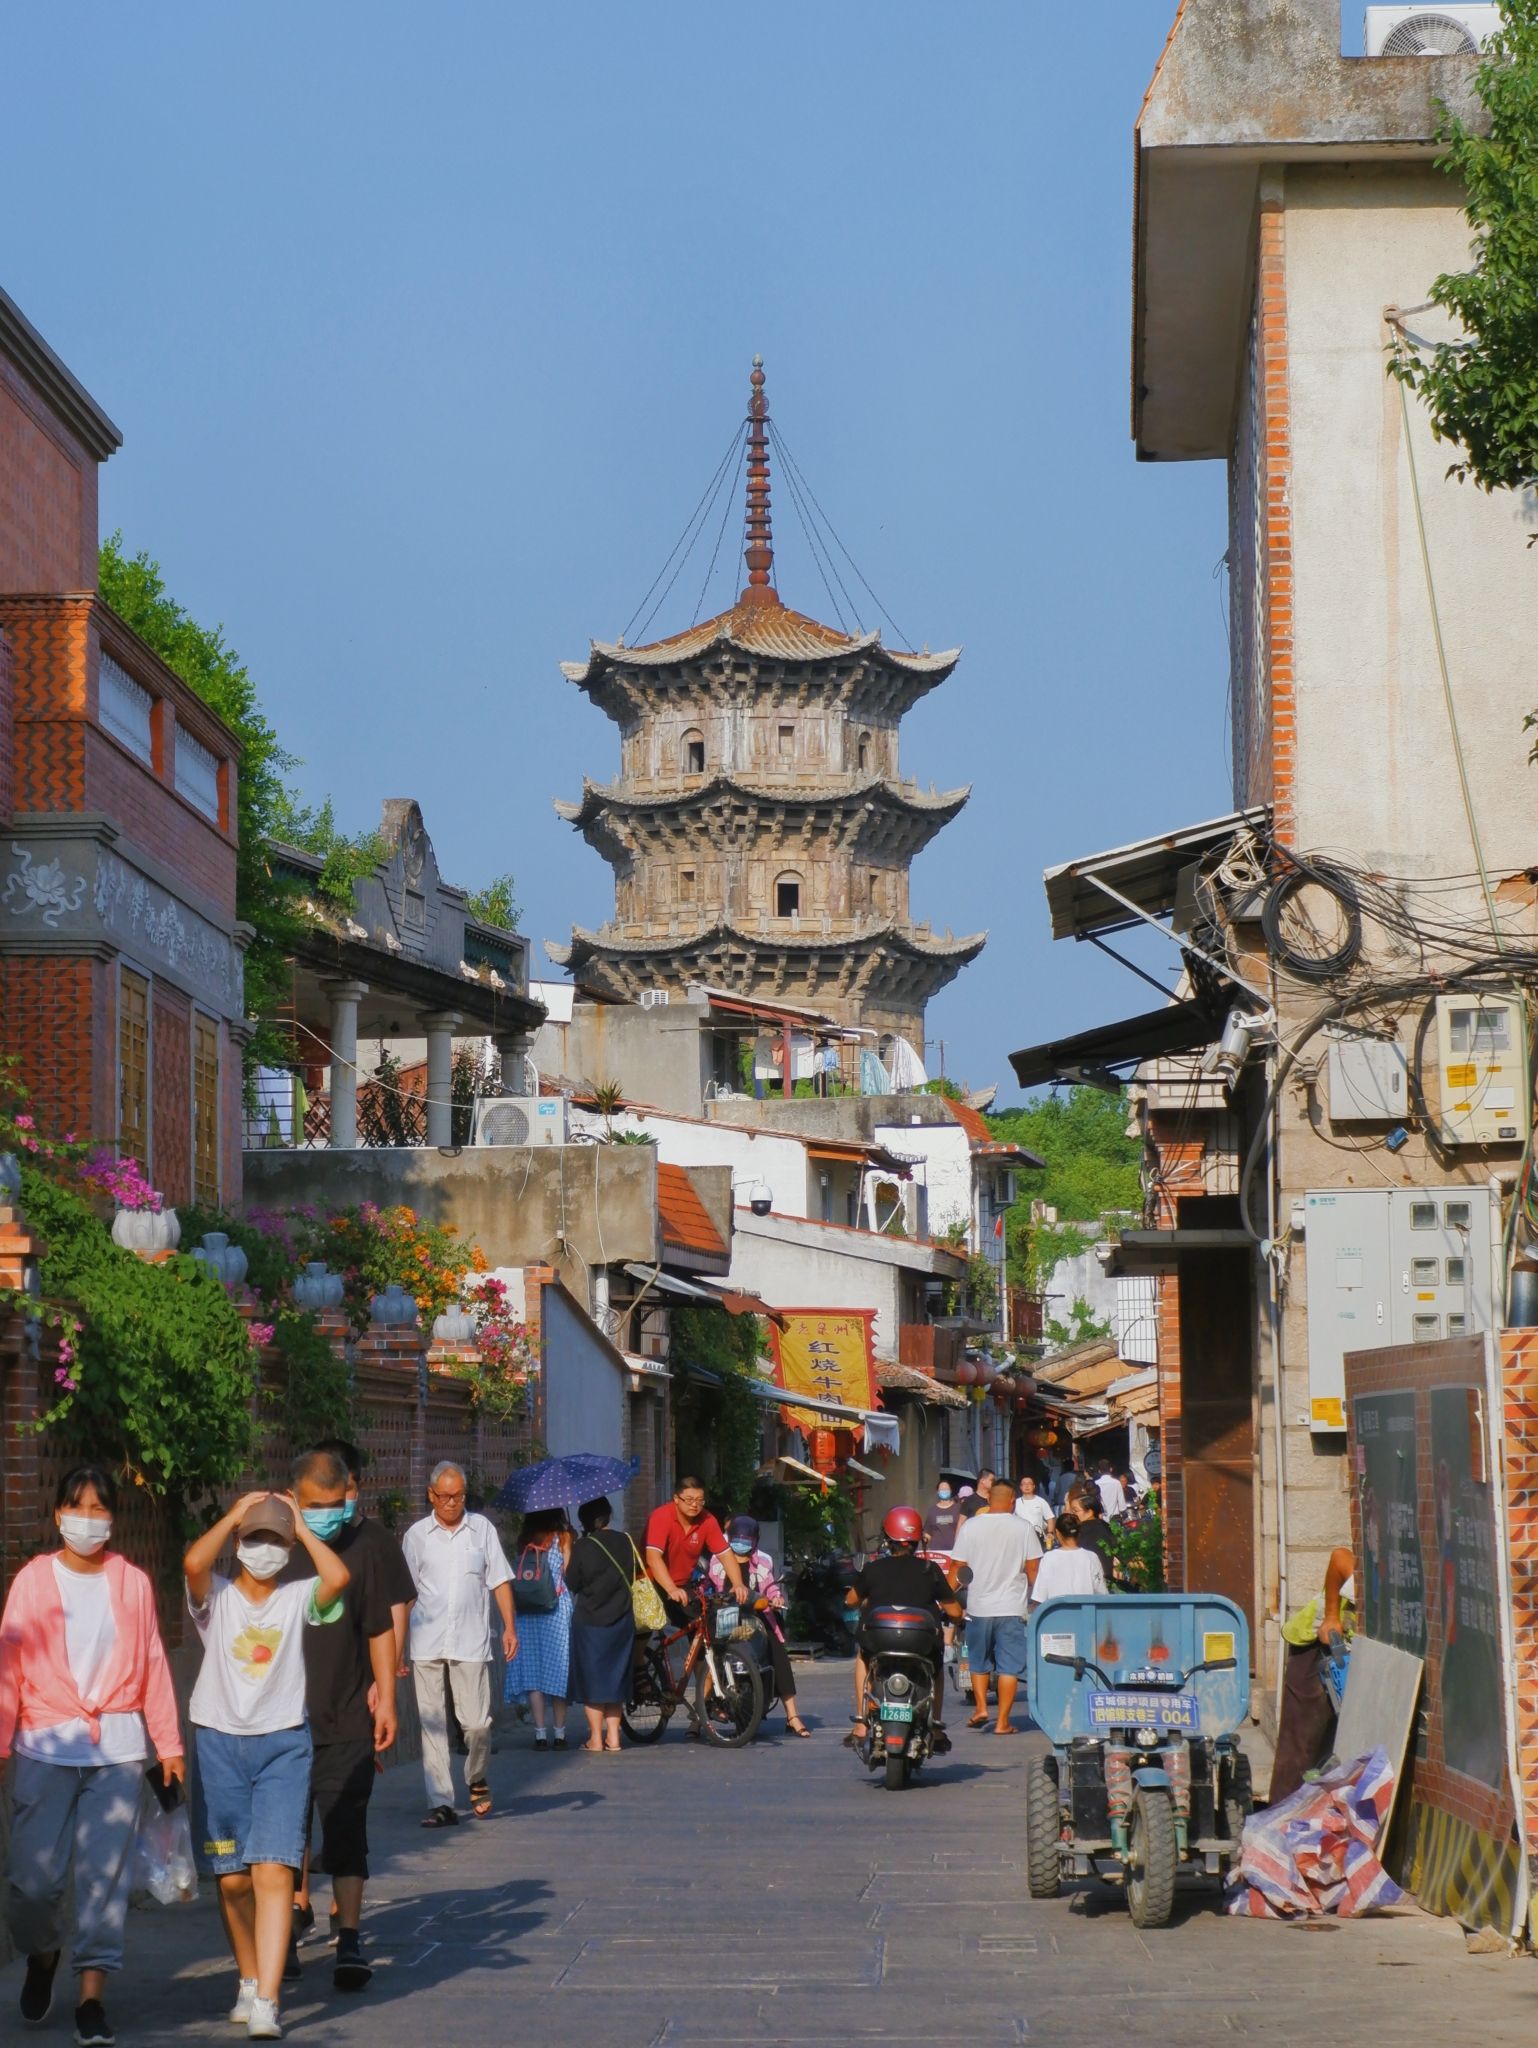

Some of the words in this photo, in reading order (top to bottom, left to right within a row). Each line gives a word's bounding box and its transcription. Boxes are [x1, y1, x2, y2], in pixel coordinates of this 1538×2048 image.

[797, 1321, 849, 1336] 老泉州
[1094, 1696, 1192, 1709] 古城保护项目专用车
[1161, 1710, 1191, 1725] 004
